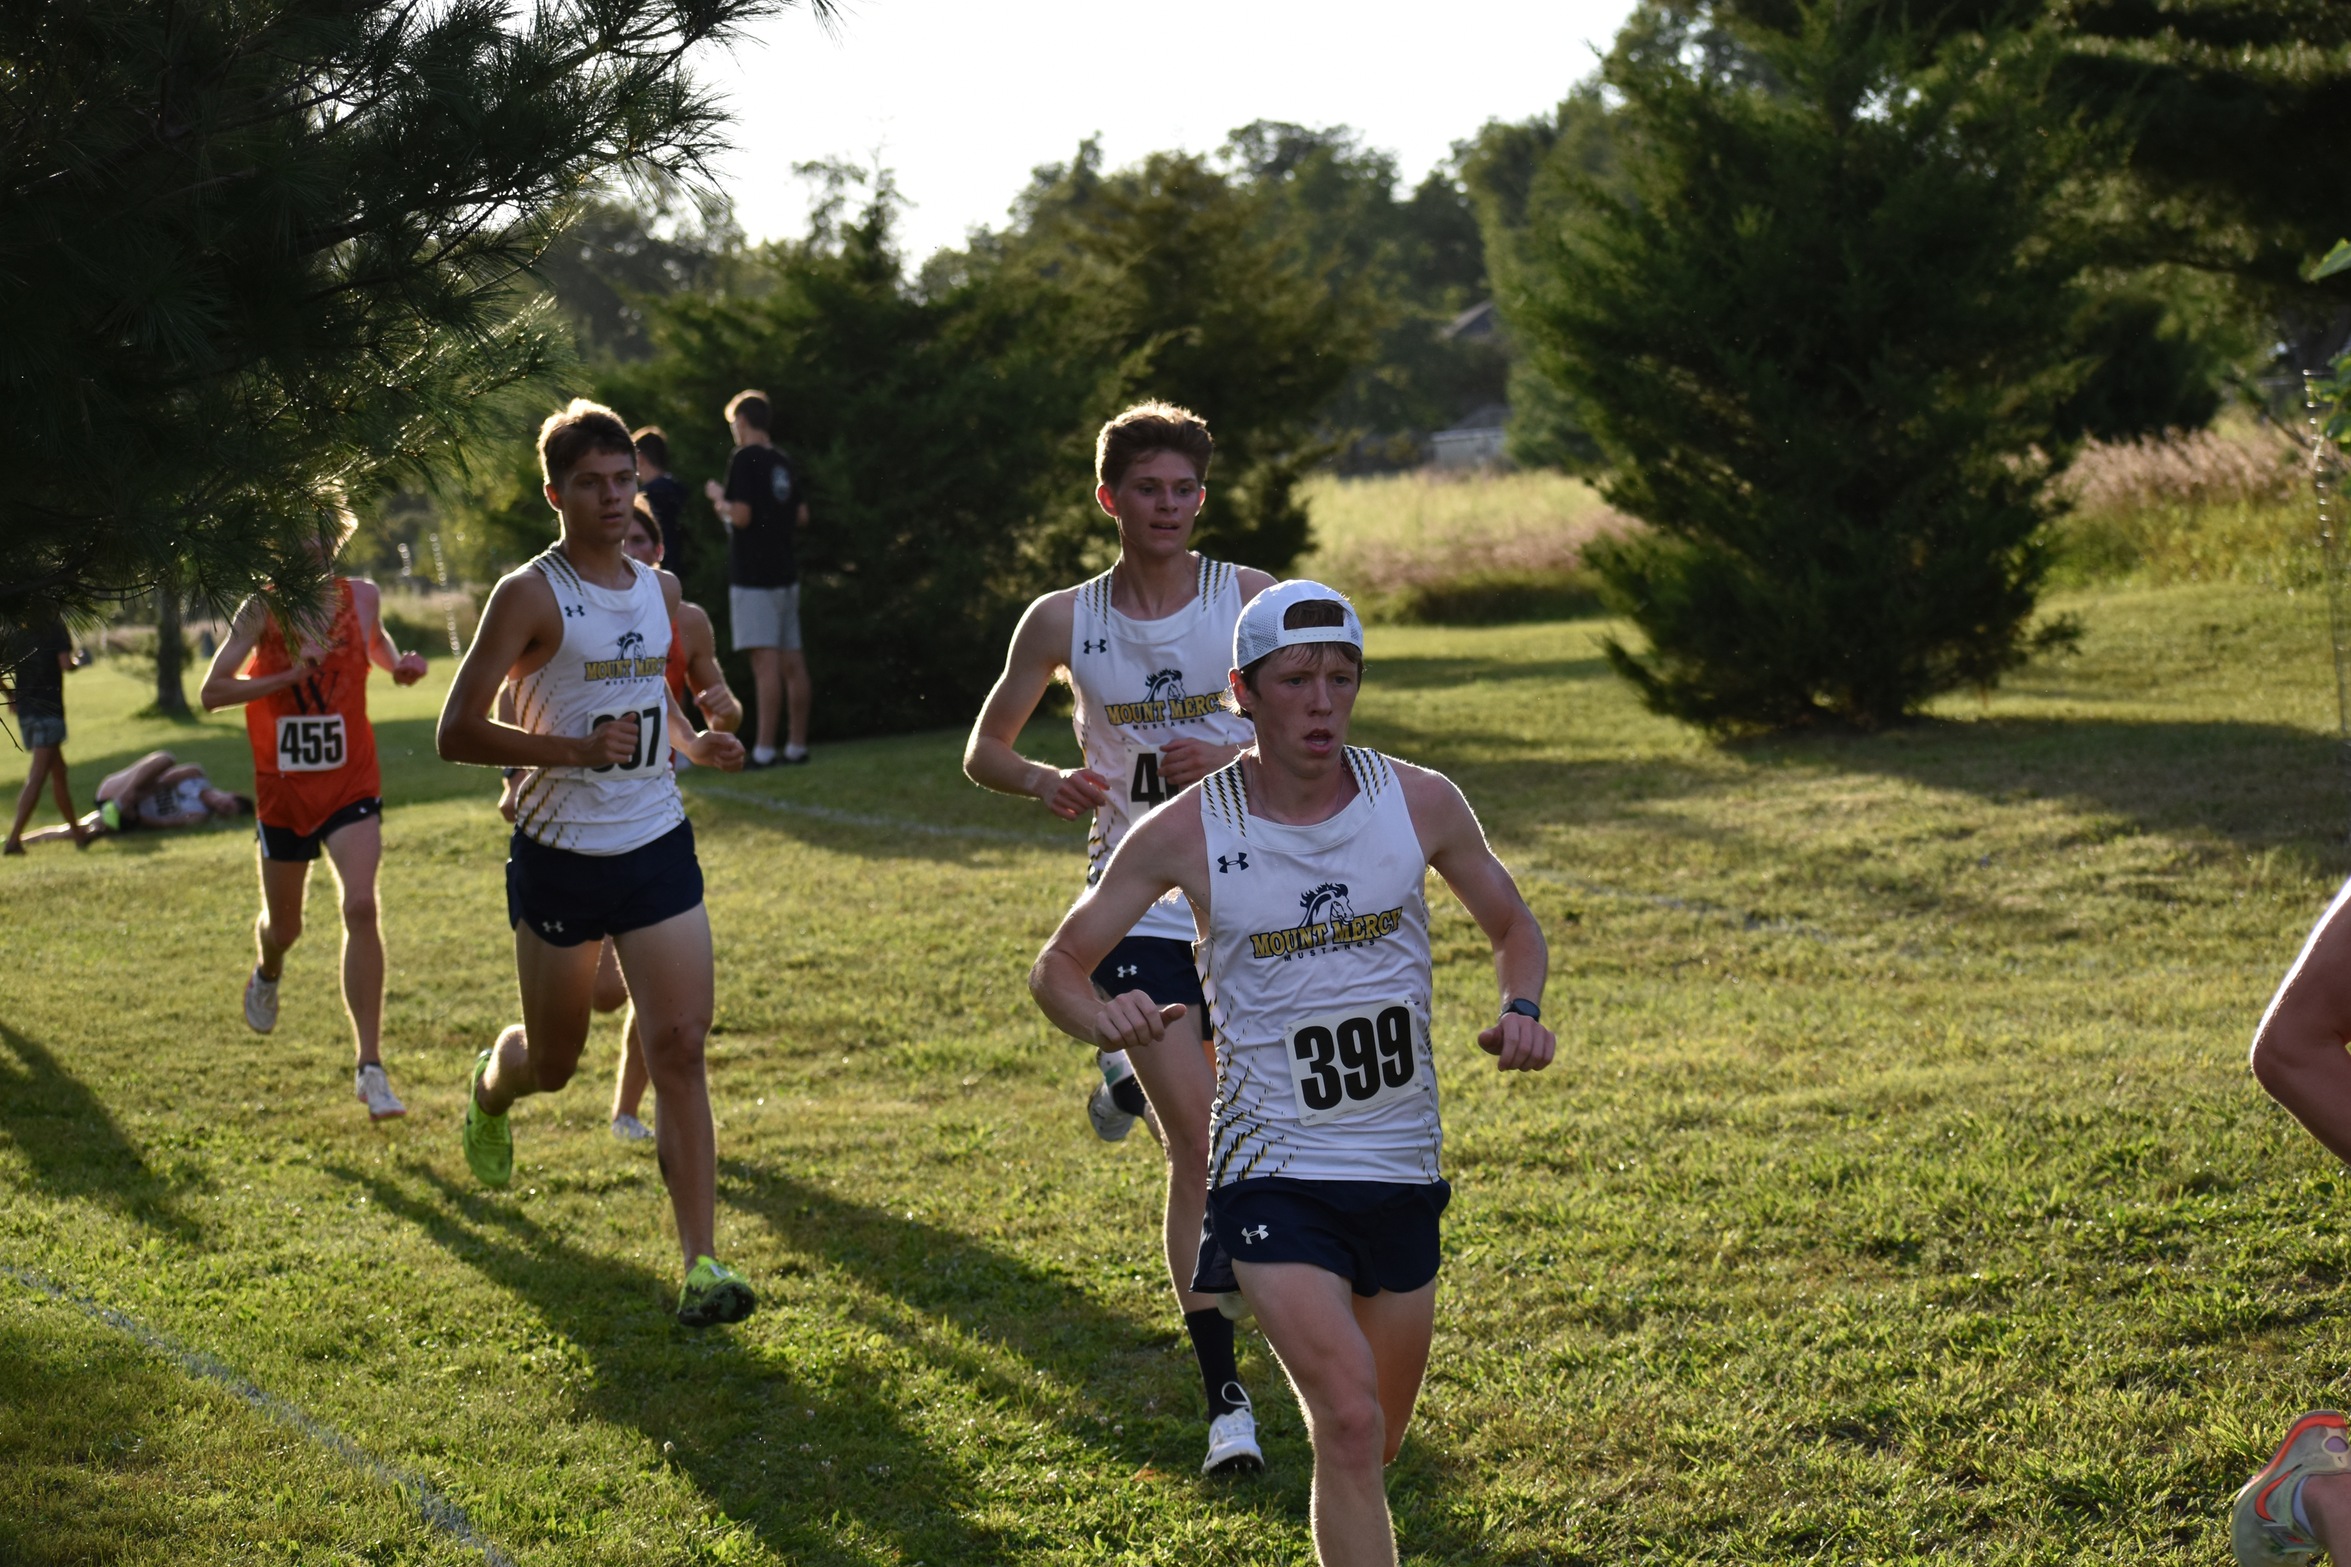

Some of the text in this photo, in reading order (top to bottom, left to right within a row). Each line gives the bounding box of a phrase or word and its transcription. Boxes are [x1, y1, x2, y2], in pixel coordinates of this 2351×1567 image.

[584, 658, 632, 681] MOUNT
[1104, 700, 1166, 726] MOUNT
[1133, 717, 1205, 730] MUSTANGS
[280, 721, 343, 765] 455
[1249, 906, 1403, 959] MOUNT MERCY
[1284, 940, 1375, 962] MUSTANGS
[1293, 1006, 1415, 1110] 399
